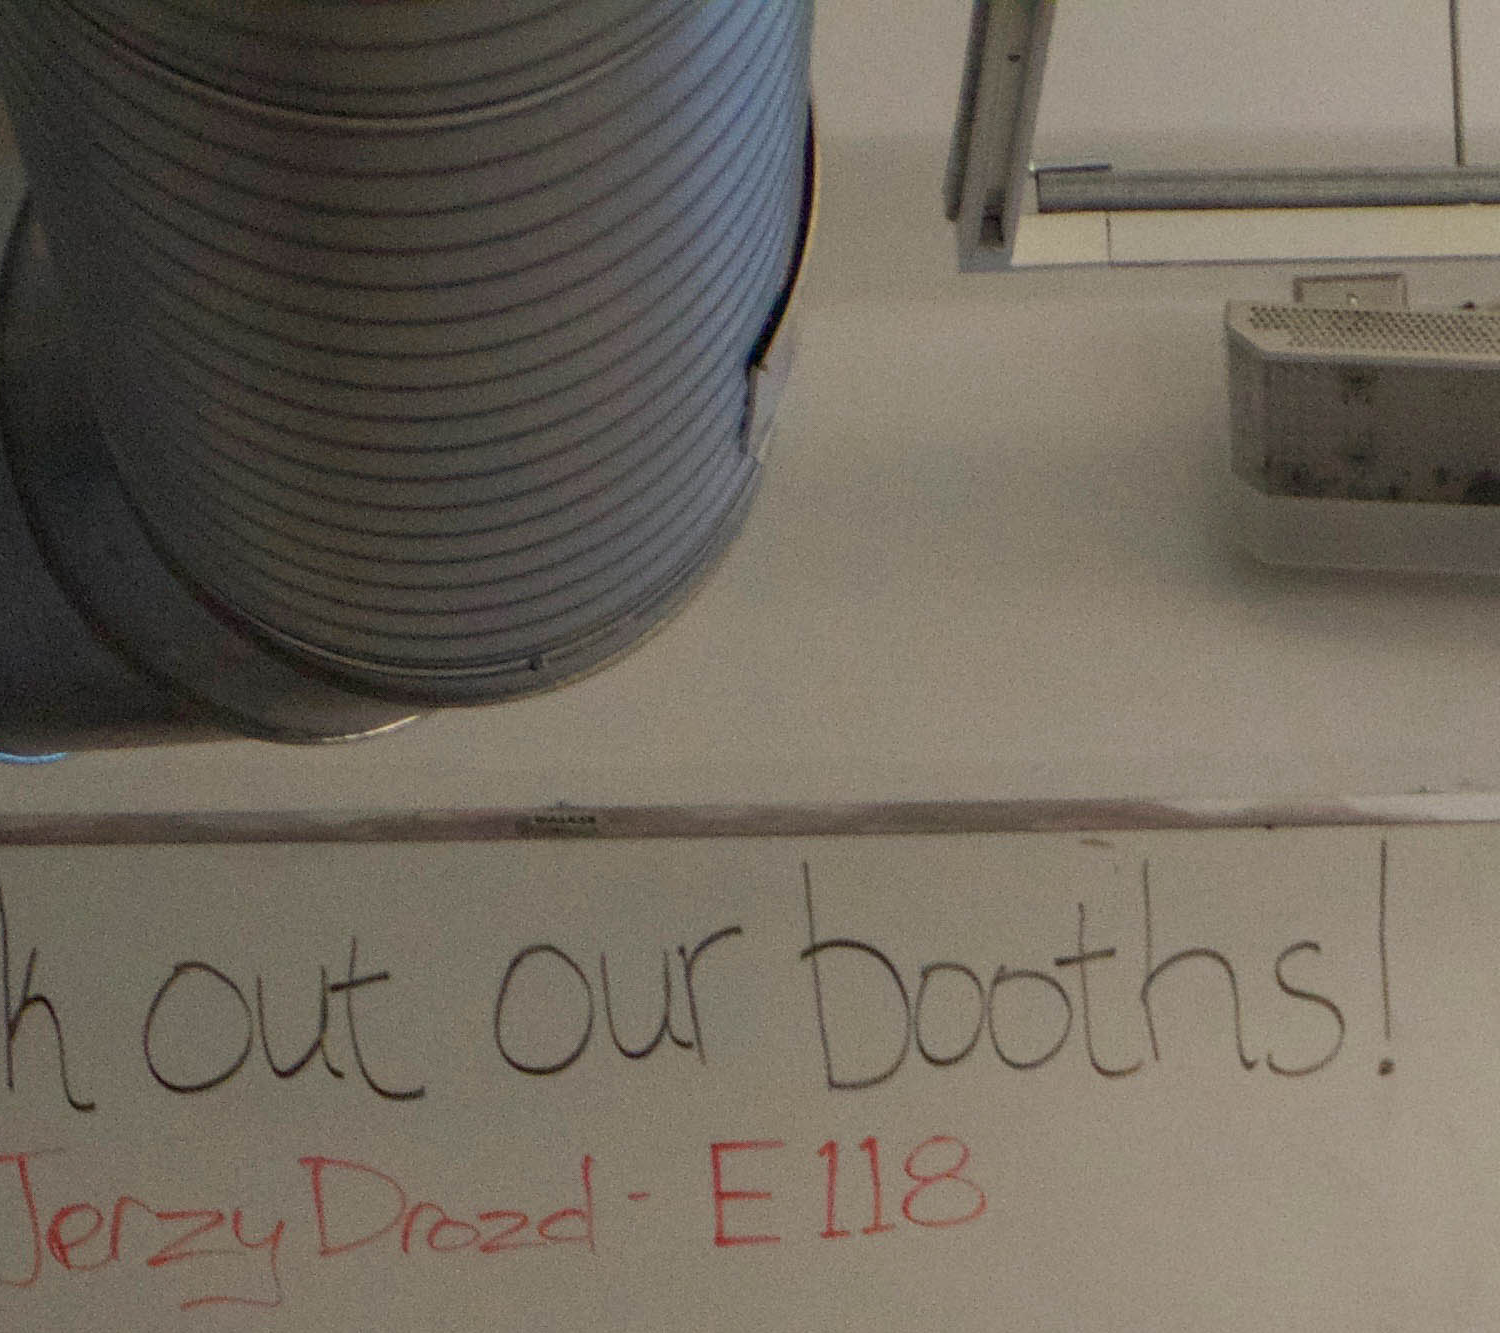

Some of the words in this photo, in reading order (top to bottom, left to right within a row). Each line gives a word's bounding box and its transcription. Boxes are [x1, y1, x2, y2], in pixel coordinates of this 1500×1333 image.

[143, 937, 426, 1102] out
[494, 925, 744, 1077] our
[800, 839, 1395, 1092] booths!
[299, 1154, 596, 1258] Drozd
[708, 1134, 989, 1249] E118
